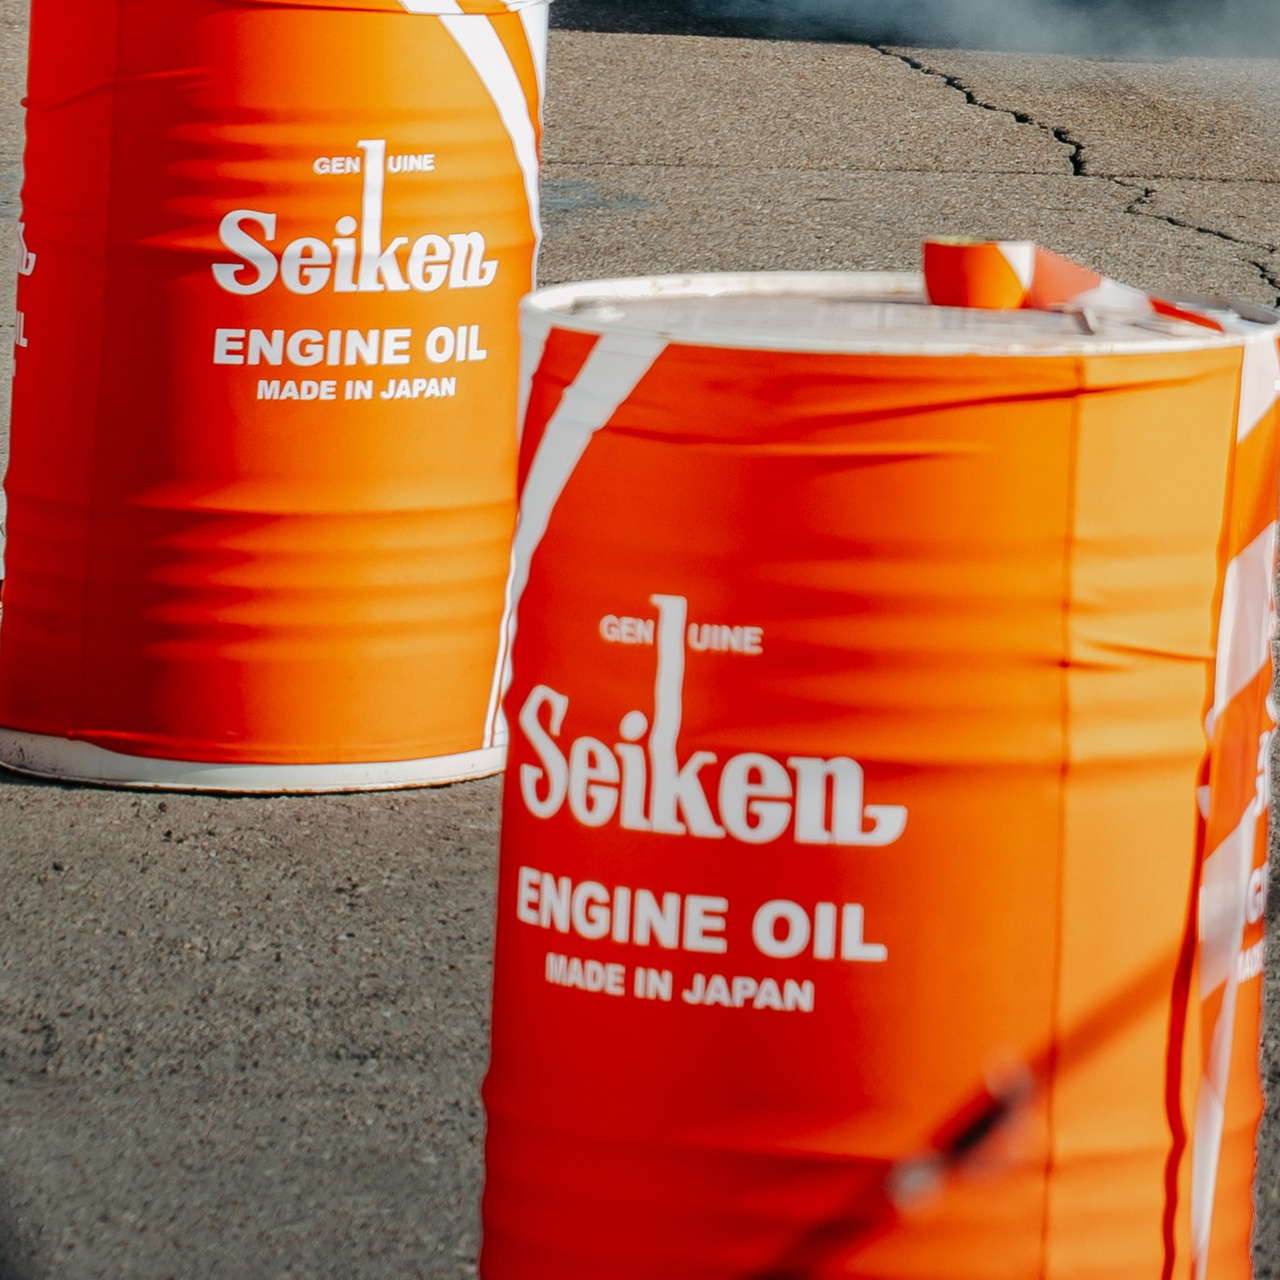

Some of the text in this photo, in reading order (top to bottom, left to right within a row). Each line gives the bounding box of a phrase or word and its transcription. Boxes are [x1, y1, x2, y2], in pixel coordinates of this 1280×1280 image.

[211, 139, 498, 295] Seiken
[213, 324, 487, 366] ENGINE OIL
[256, 376, 456, 400] MADE IN JAPAN
[519, 594, 908, 846] Seiken
[516, 865, 888, 962] ENGINE OIL
[546, 951, 814, 1012] MADE IN JAPAN
